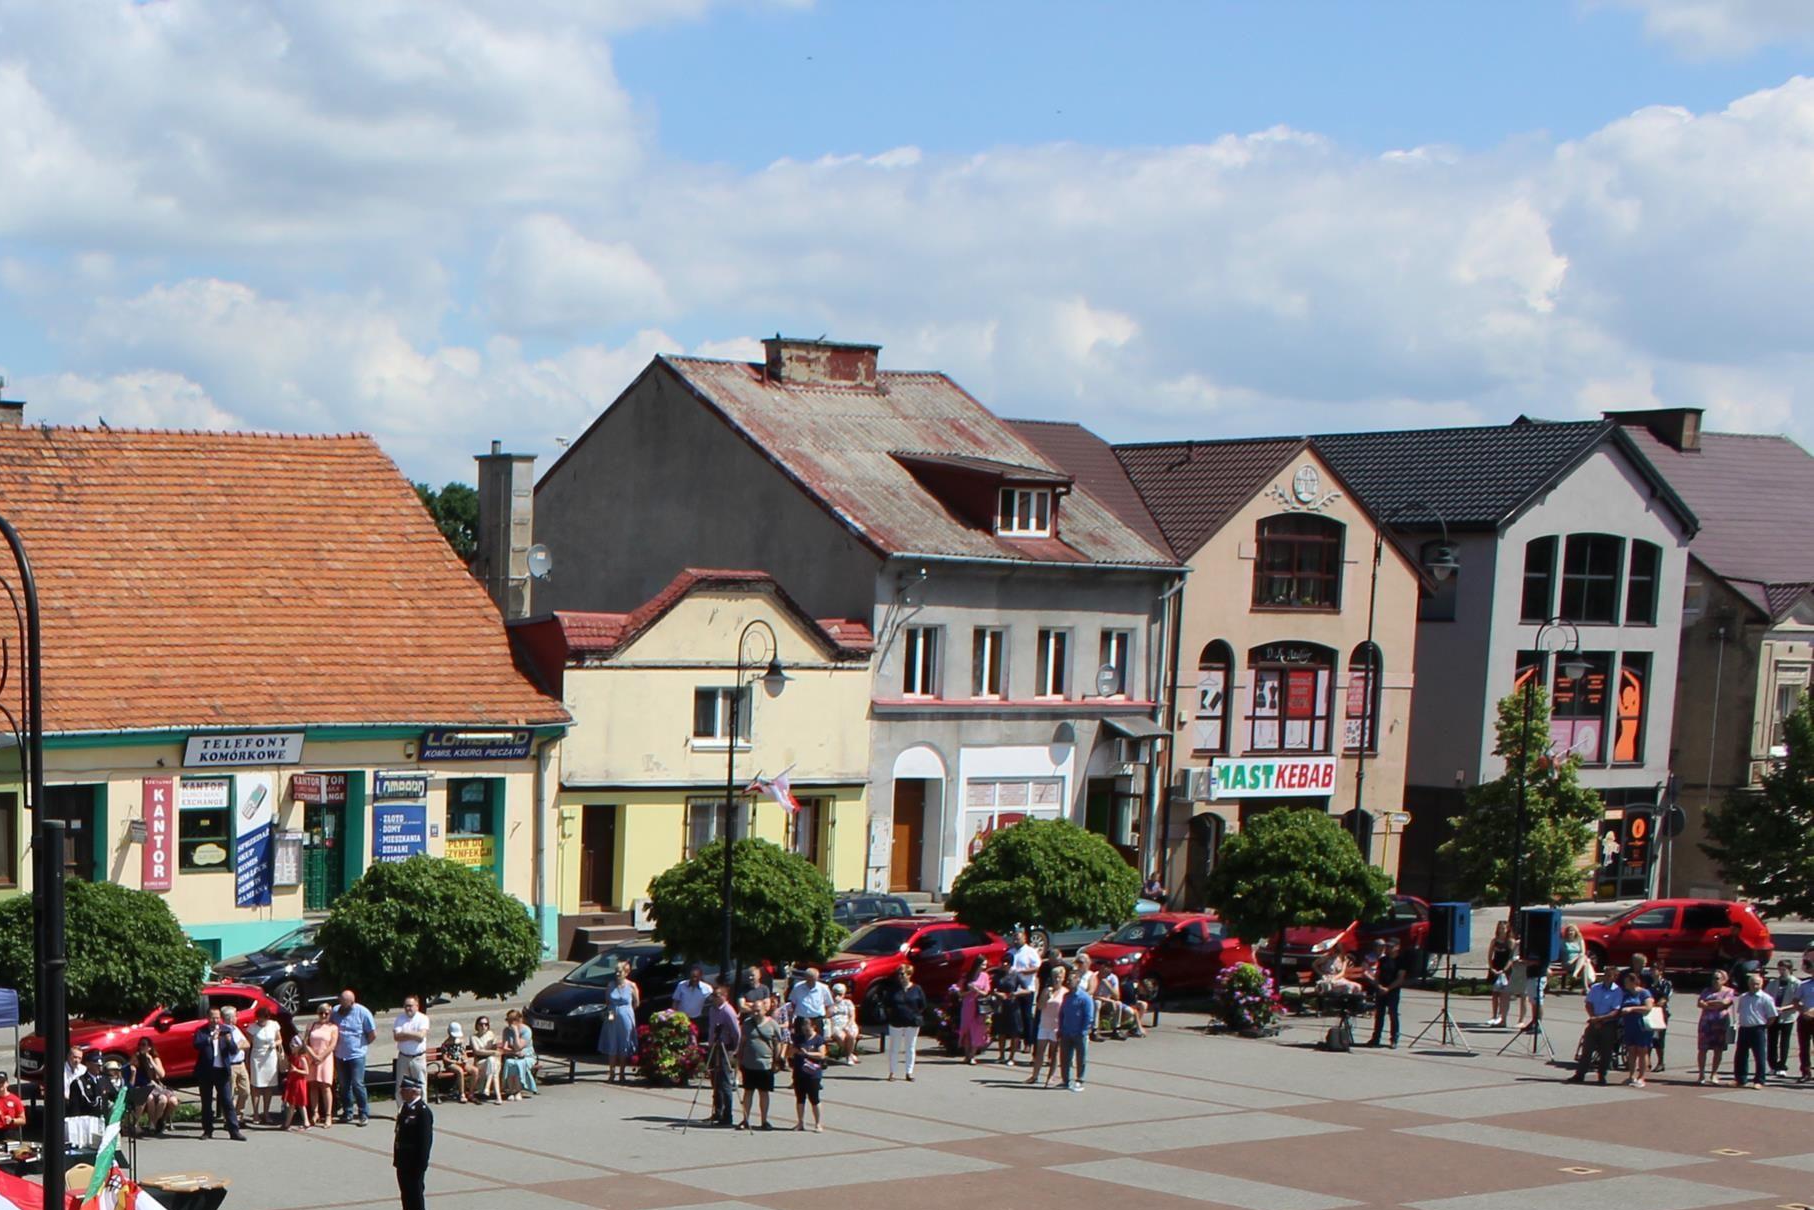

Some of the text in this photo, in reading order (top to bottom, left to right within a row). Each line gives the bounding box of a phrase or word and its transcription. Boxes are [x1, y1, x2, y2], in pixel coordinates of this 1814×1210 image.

[201, 737, 289, 749] TELEFONY
[199, 749, 287, 762] KOMÓRKOWE
[181, 781, 224, 791] KANTOR
[181, 798, 224, 806] EXCHANGE
[152, 788, 166, 878] KANTOR
[382, 824, 401, 833] DOMY
